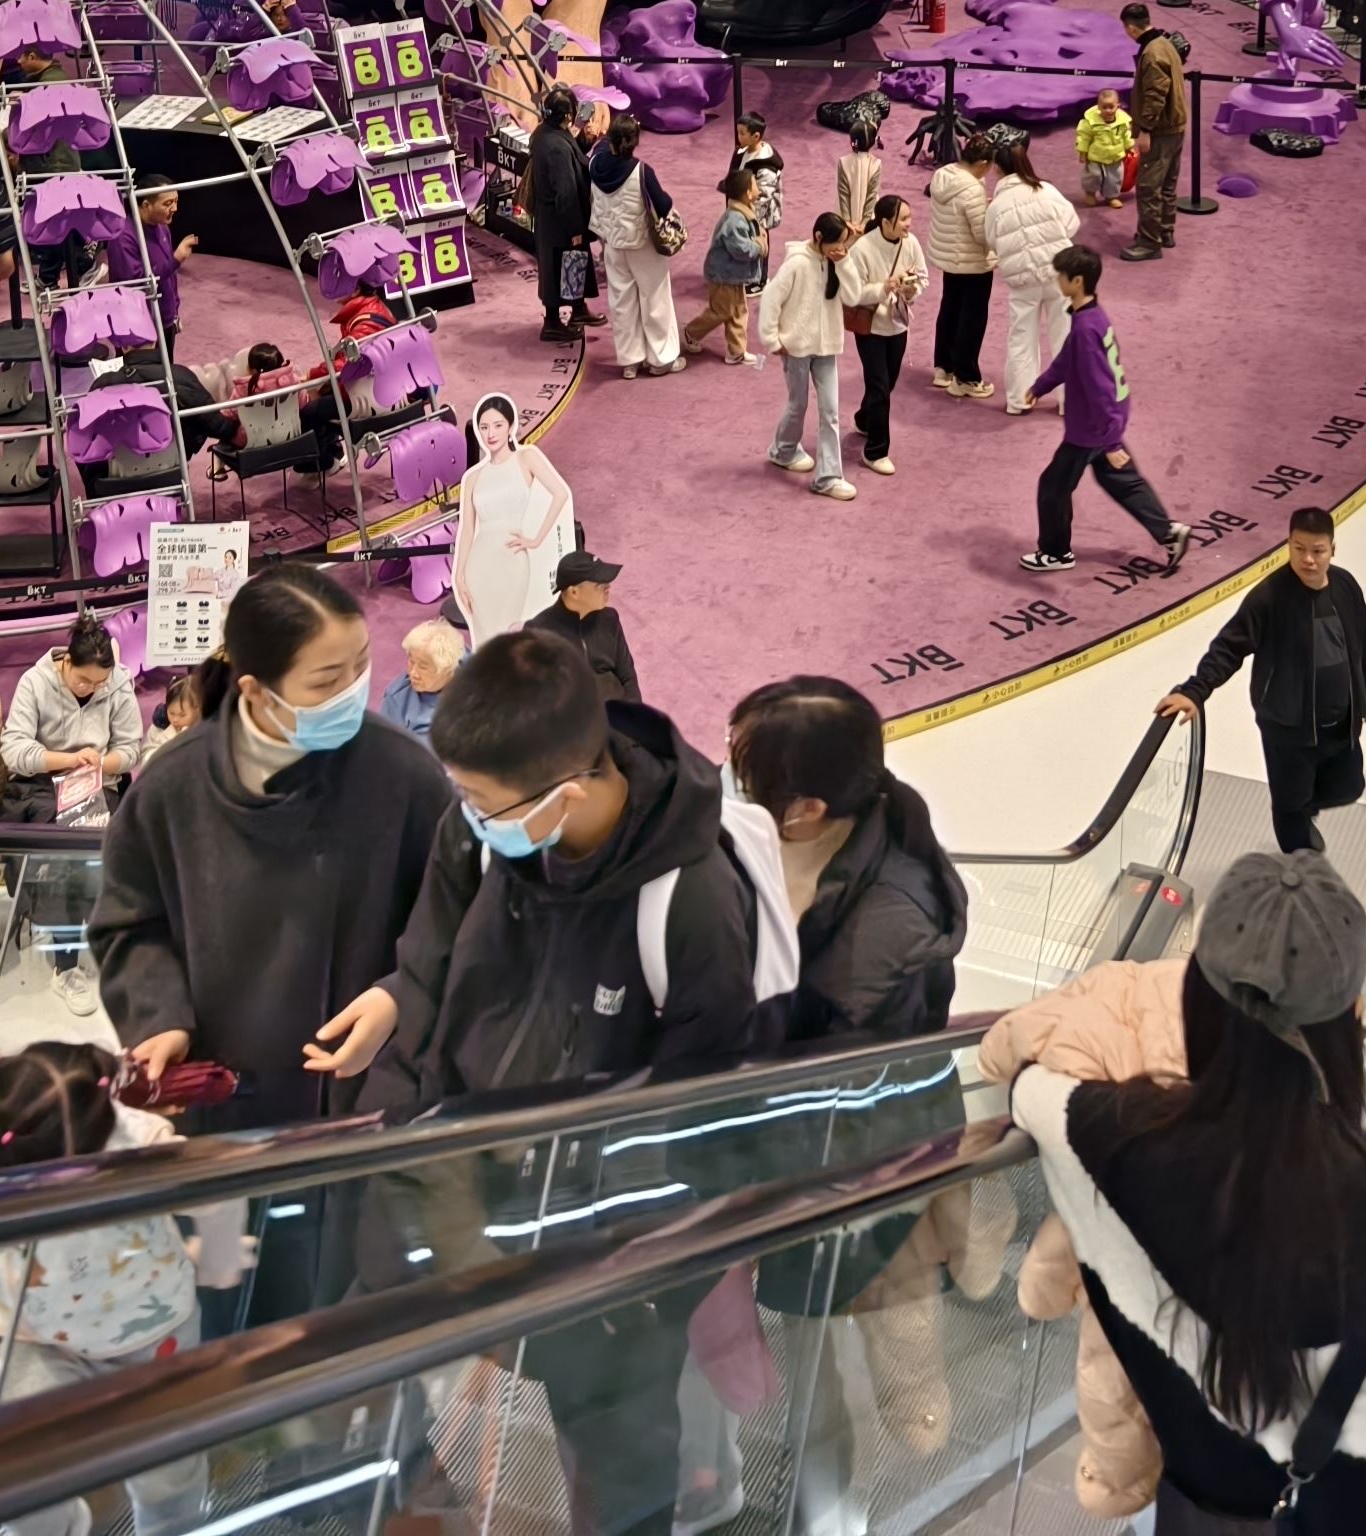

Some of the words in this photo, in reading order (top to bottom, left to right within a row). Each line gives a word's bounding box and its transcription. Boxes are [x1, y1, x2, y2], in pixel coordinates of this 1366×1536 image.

[497, 146, 517, 171] BKT
[1250, 463, 1324, 501] BKT
[1186, 509, 1260, 548] BKT
[156, 543, 218, 555] 全球销量第一
[353, 551, 373, 562] BKT
[26, 584, 47, 597] BKT
[127, 572, 147, 585] BKT
[988, 599, 1078, 642] BKT
[870, 643, 965, 686] BKT
